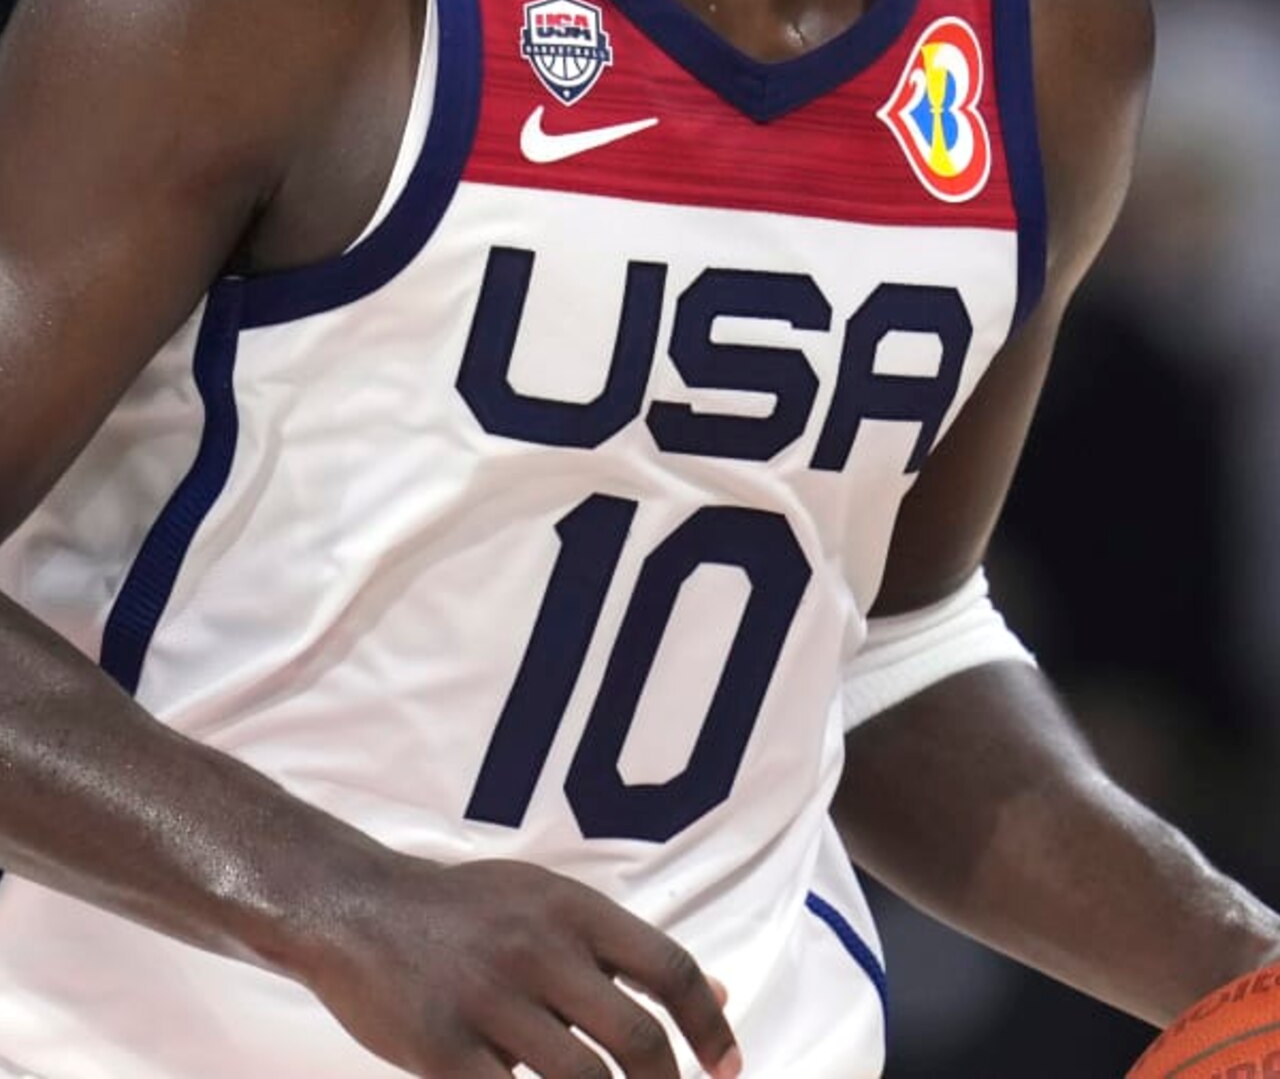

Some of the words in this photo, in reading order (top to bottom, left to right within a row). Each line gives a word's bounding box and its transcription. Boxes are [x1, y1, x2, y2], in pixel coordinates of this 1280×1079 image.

[535, 13, 591, 40] USA
[455, 245, 973, 474] USA
[463, 492, 813, 844] 10
